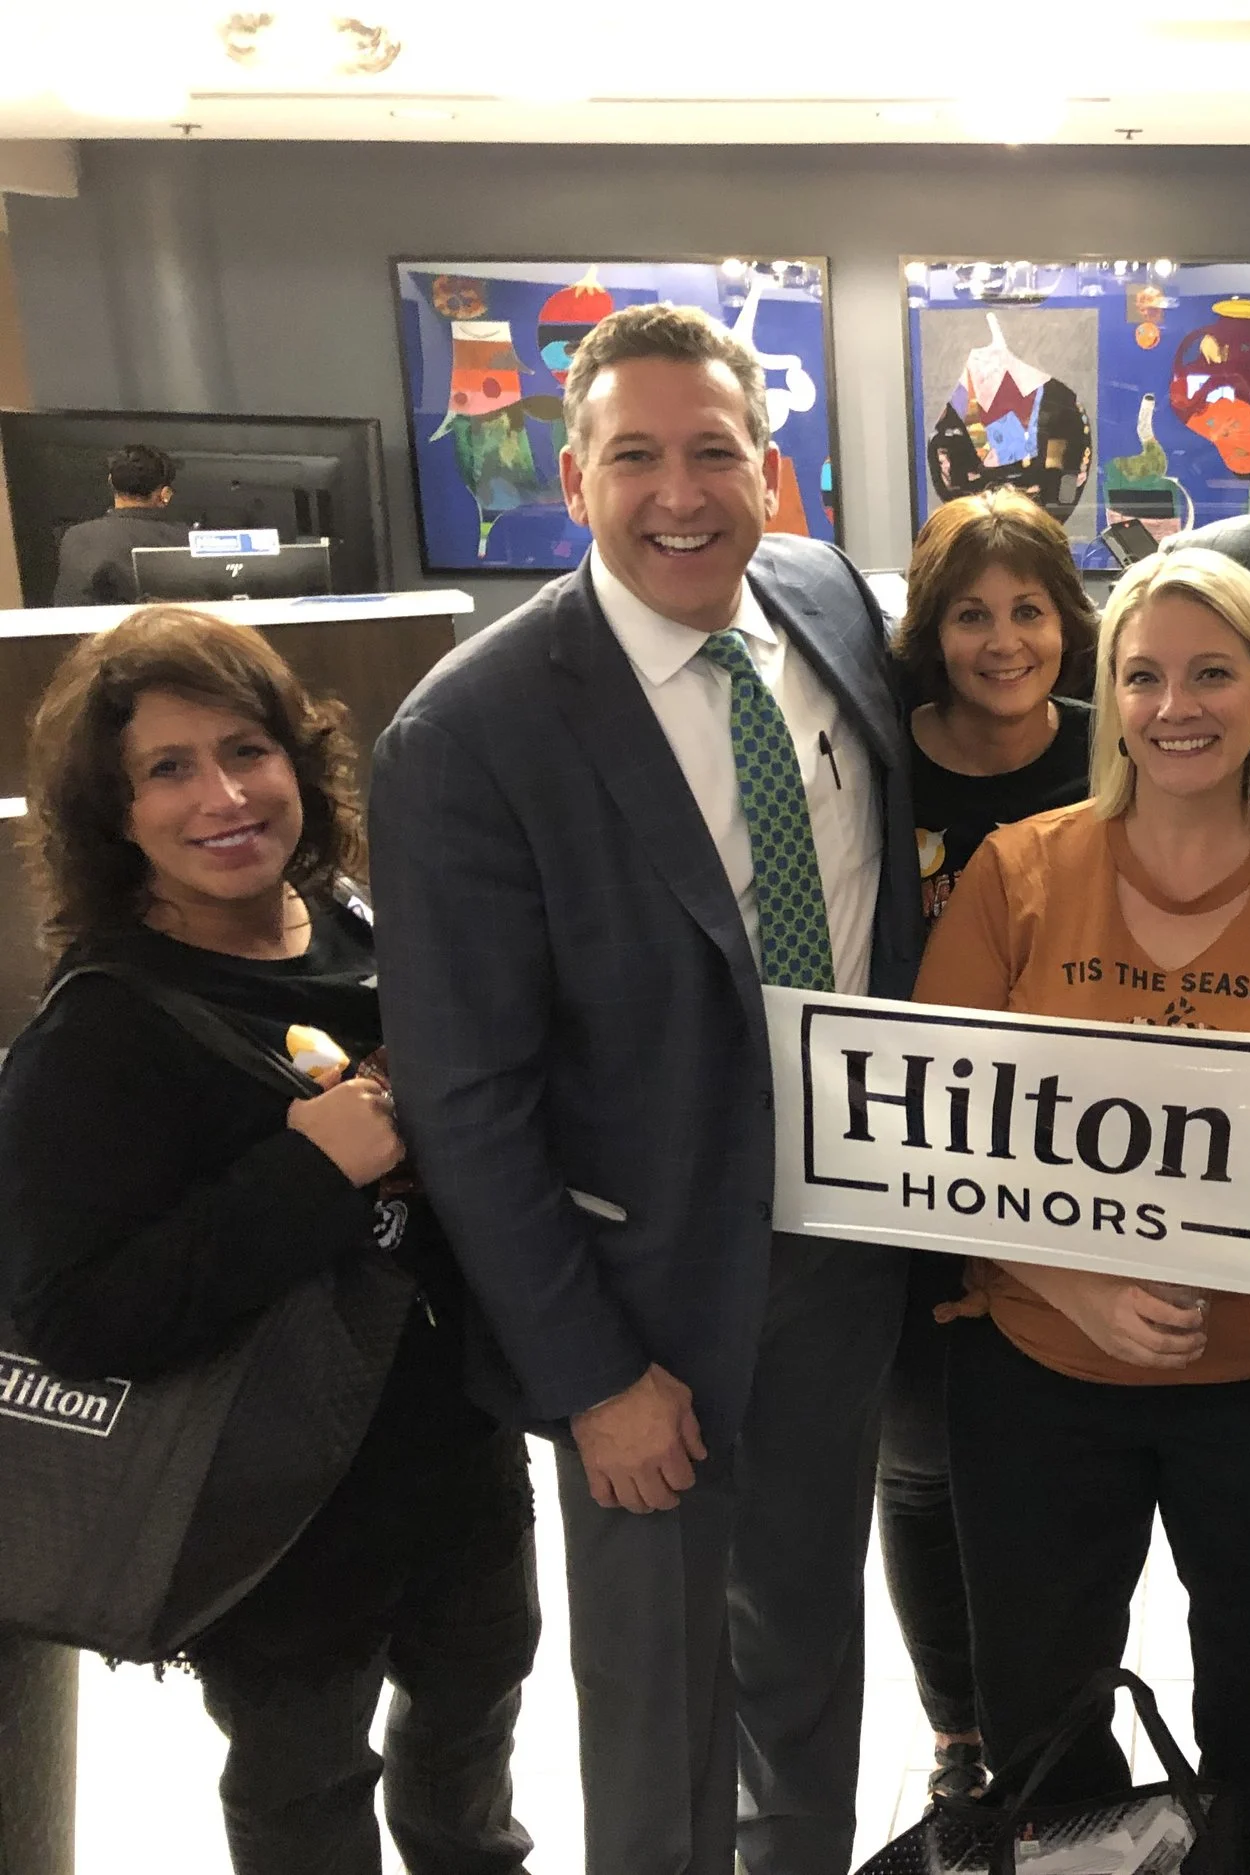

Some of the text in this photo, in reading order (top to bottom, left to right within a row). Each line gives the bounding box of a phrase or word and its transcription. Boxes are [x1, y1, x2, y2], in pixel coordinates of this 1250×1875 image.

[1062, 957, 1103, 985] TIS
[1115, 961, 1167, 992] THE
[841, 1049, 1232, 1182] Hilton
[902, 1171, 1168, 1241] HONORS
